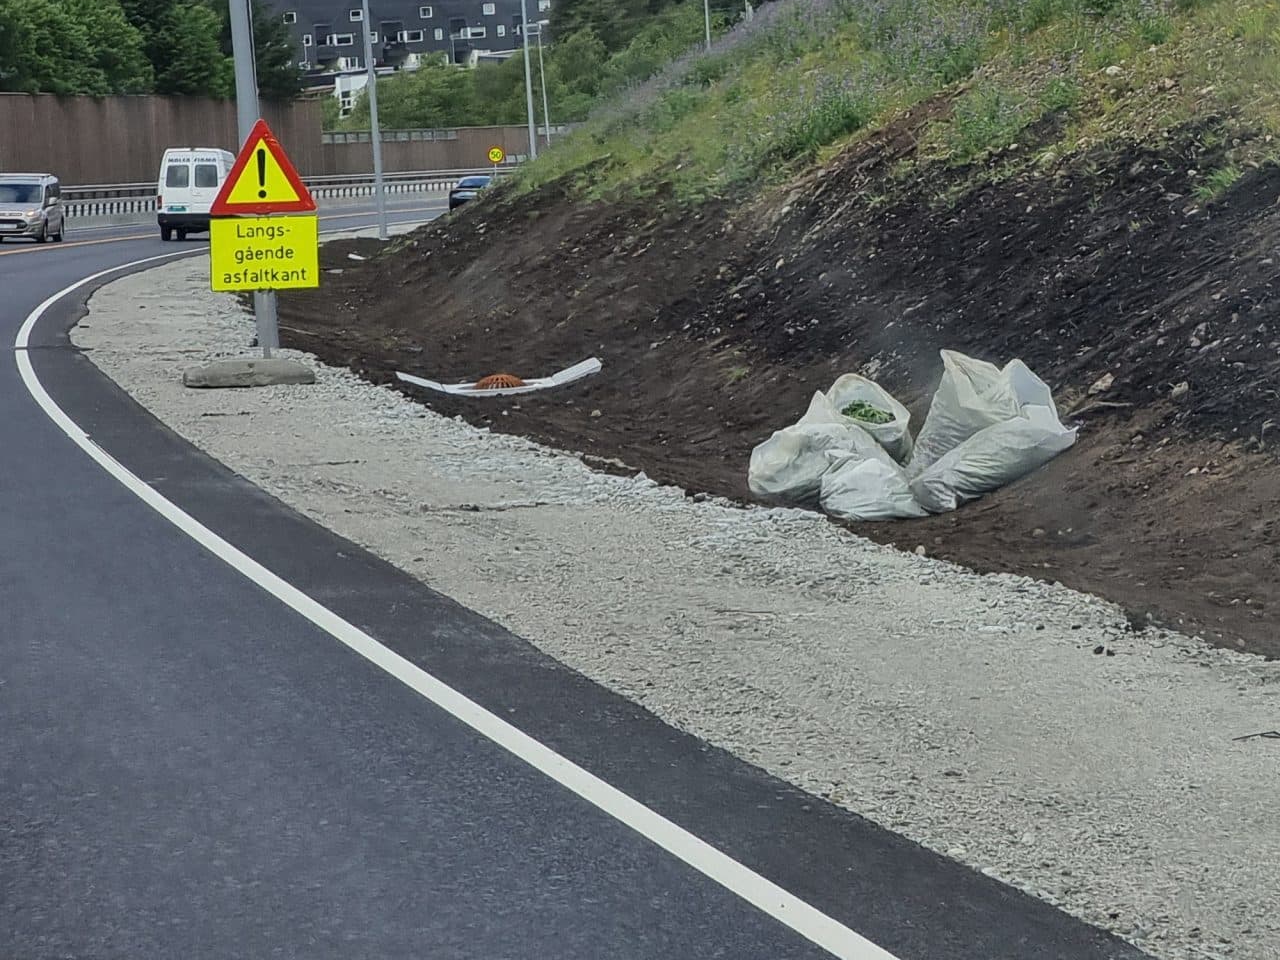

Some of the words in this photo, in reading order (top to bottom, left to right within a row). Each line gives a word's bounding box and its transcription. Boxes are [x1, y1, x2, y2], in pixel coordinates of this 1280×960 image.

[491, 150, 502, 159] 50
[237, 224, 291, 240] Langs-
[235, 245, 294, 264] gående
[223, 268, 307, 284] asfaltkant
